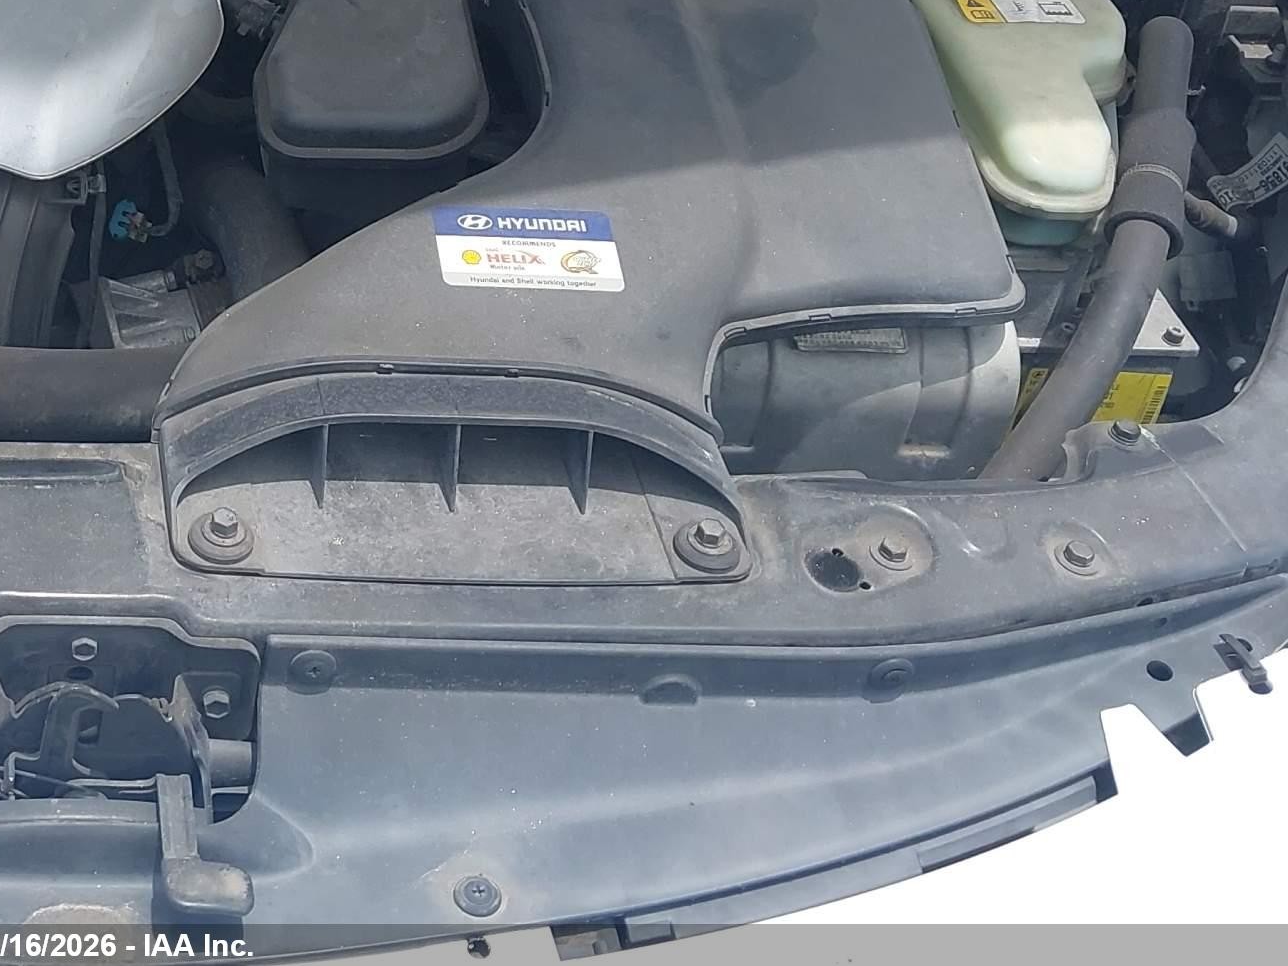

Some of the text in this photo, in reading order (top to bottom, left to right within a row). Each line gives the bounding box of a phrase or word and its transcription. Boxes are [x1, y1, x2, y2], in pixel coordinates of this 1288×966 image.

[497, 217, 588, 232] HYUNDAI
[487, 251, 543, 265] HELIX
[537, 279, 565, 287] working
